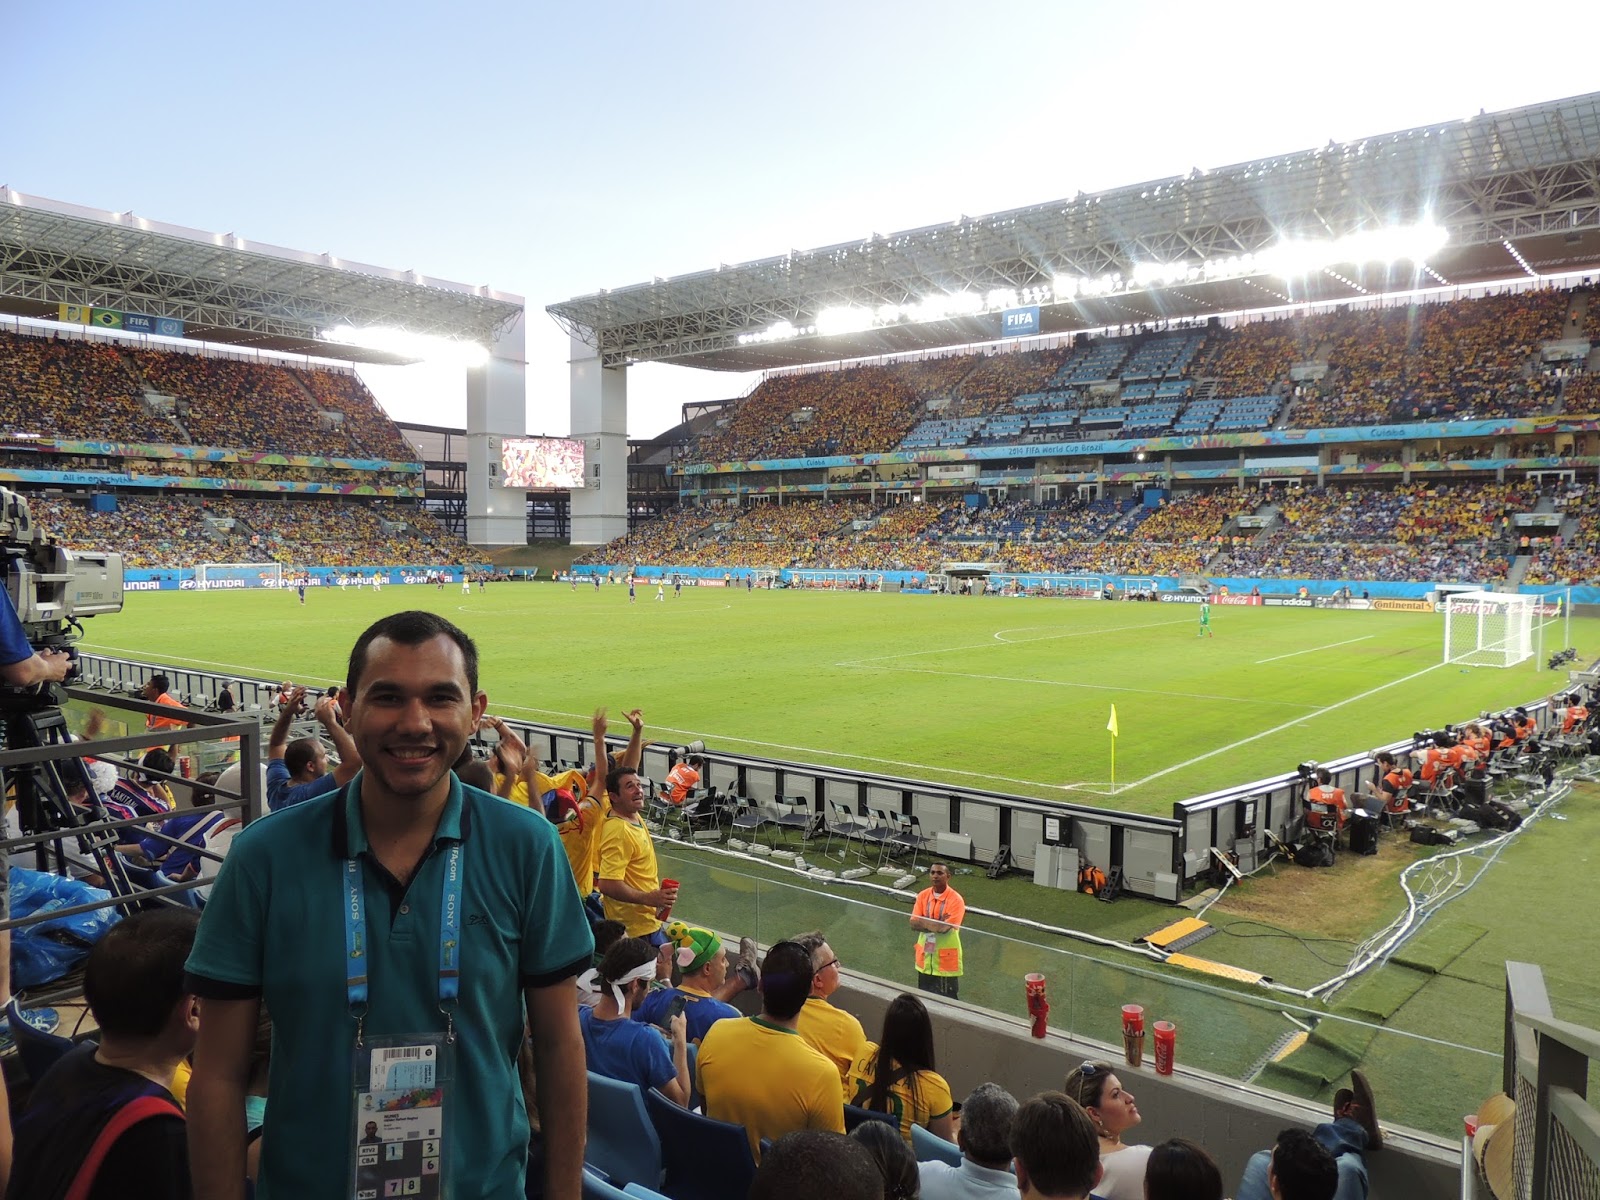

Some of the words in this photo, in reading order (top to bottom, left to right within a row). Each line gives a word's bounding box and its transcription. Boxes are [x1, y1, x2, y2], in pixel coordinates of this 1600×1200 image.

[129, 317, 149, 327] FIFA
[1007, 312, 1033, 326] FIFA
[1008, 448, 1023, 456] 2014
[1026, 446, 1040, 454] FIFA
[1043, 445, 1063, 454] World
[1066, 445, 1079, 453] Cup
[1082, 443, 1104, 452] Brazil
[62, 473, 75, 482] All
[77, 474, 86, 483] in
[106, 476, 133, 485] rhyth
[122, 581, 160, 590] UNDAI
[197, 579, 244, 588] HYUNDAI
[1282, 597, 1312, 607] adidas
[1373, 600, 1425, 610] Continental
[350, 886, 360, 920] SONY
[446, 893, 456, 928] SONY
[391, 1146, 395, 1157] 1
[426, 1142, 434, 1153] 3
[427, 1160, 434, 1170] 6
[390, 1182, 398, 1193] 7
[408, 1180, 415, 1190] 8
